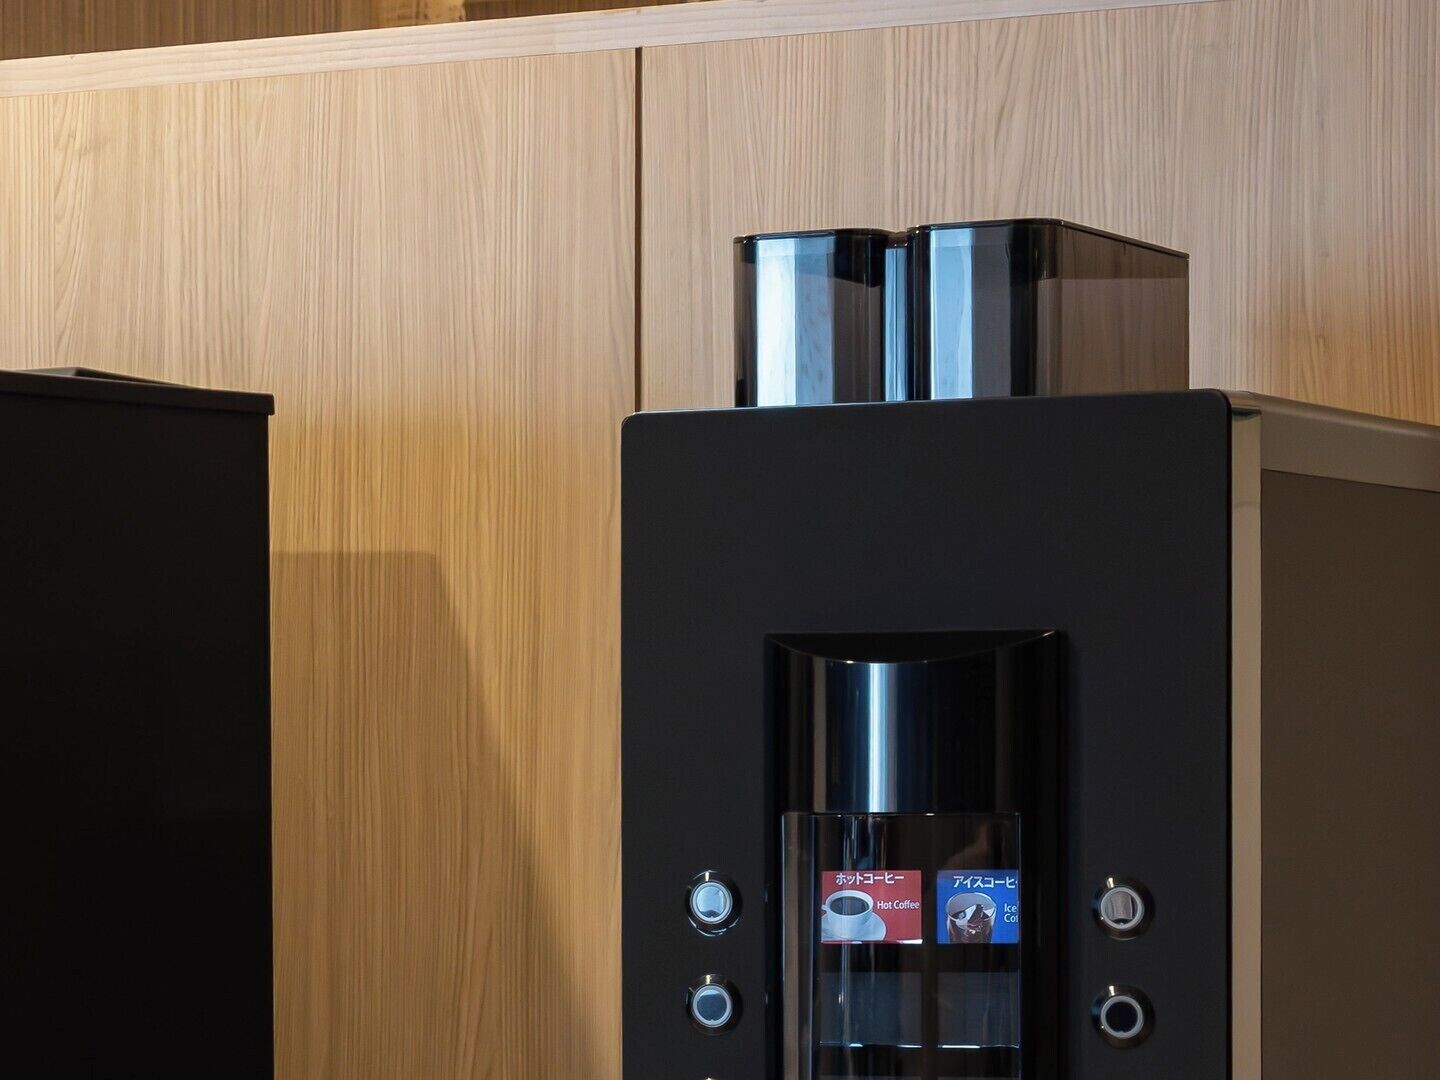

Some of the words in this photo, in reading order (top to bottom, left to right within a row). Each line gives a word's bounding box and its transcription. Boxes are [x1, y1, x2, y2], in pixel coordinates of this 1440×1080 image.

[835, 872, 905, 885] ホットコーヒー
[953, 875, 1018, 889] アイスコーヒ
[877, 901, 892, 910] Hot
[893, 900, 920, 910] Coffee
